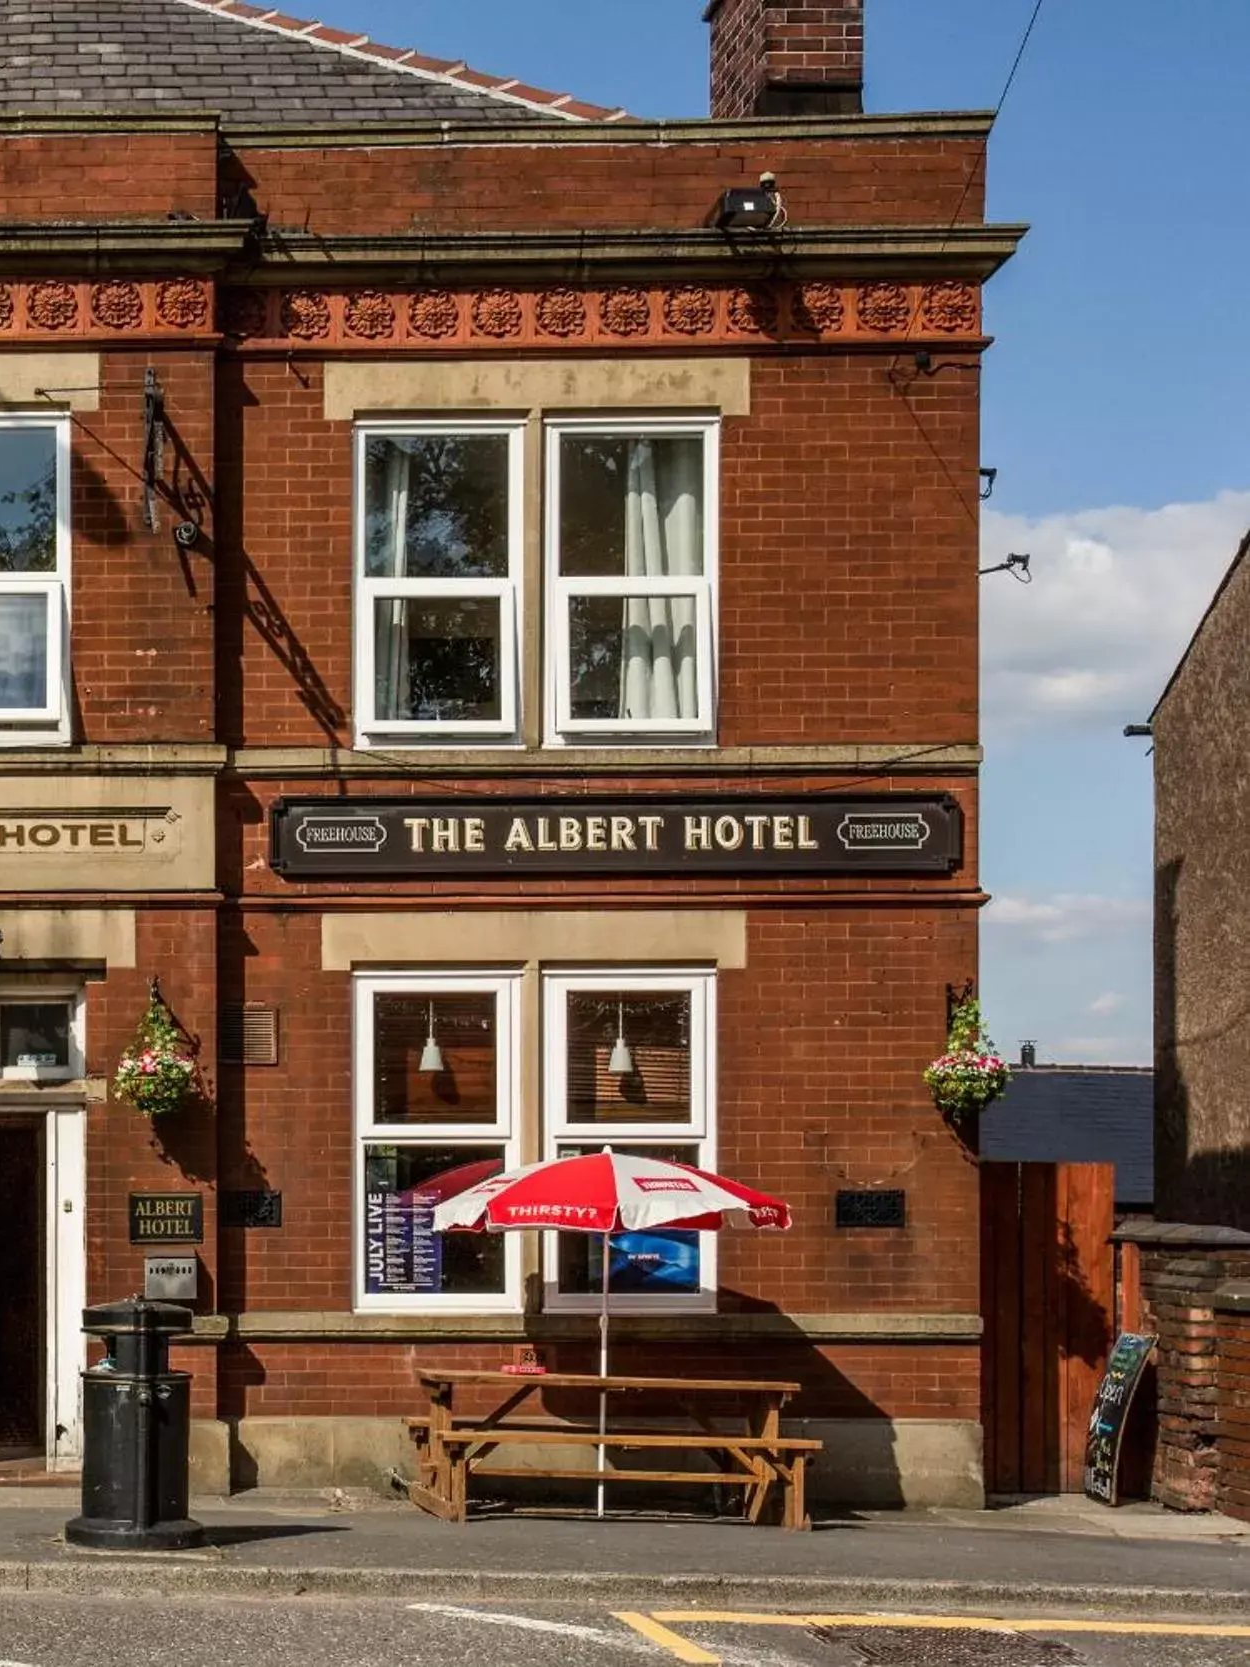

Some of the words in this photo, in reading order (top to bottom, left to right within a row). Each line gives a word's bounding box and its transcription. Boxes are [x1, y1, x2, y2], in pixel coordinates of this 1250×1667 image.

[305, 826, 377, 843] FREEHOUSE
[403, 817, 486, 852] THE
[504, 815, 665, 852] ALBERT
[683, 814, 819, 850] HOTEL
[848, 823, 920, 841] FREEHOUSE
[135, 1200, 195, 1217] ALBERT
[368, 1193, 383, 1235] LIVE
[507, 1204, 598, 1220] THIRSTY?
[138, 1218, 195, 1235] HOTEL
[368, 1238, 384, 1282] JULY
